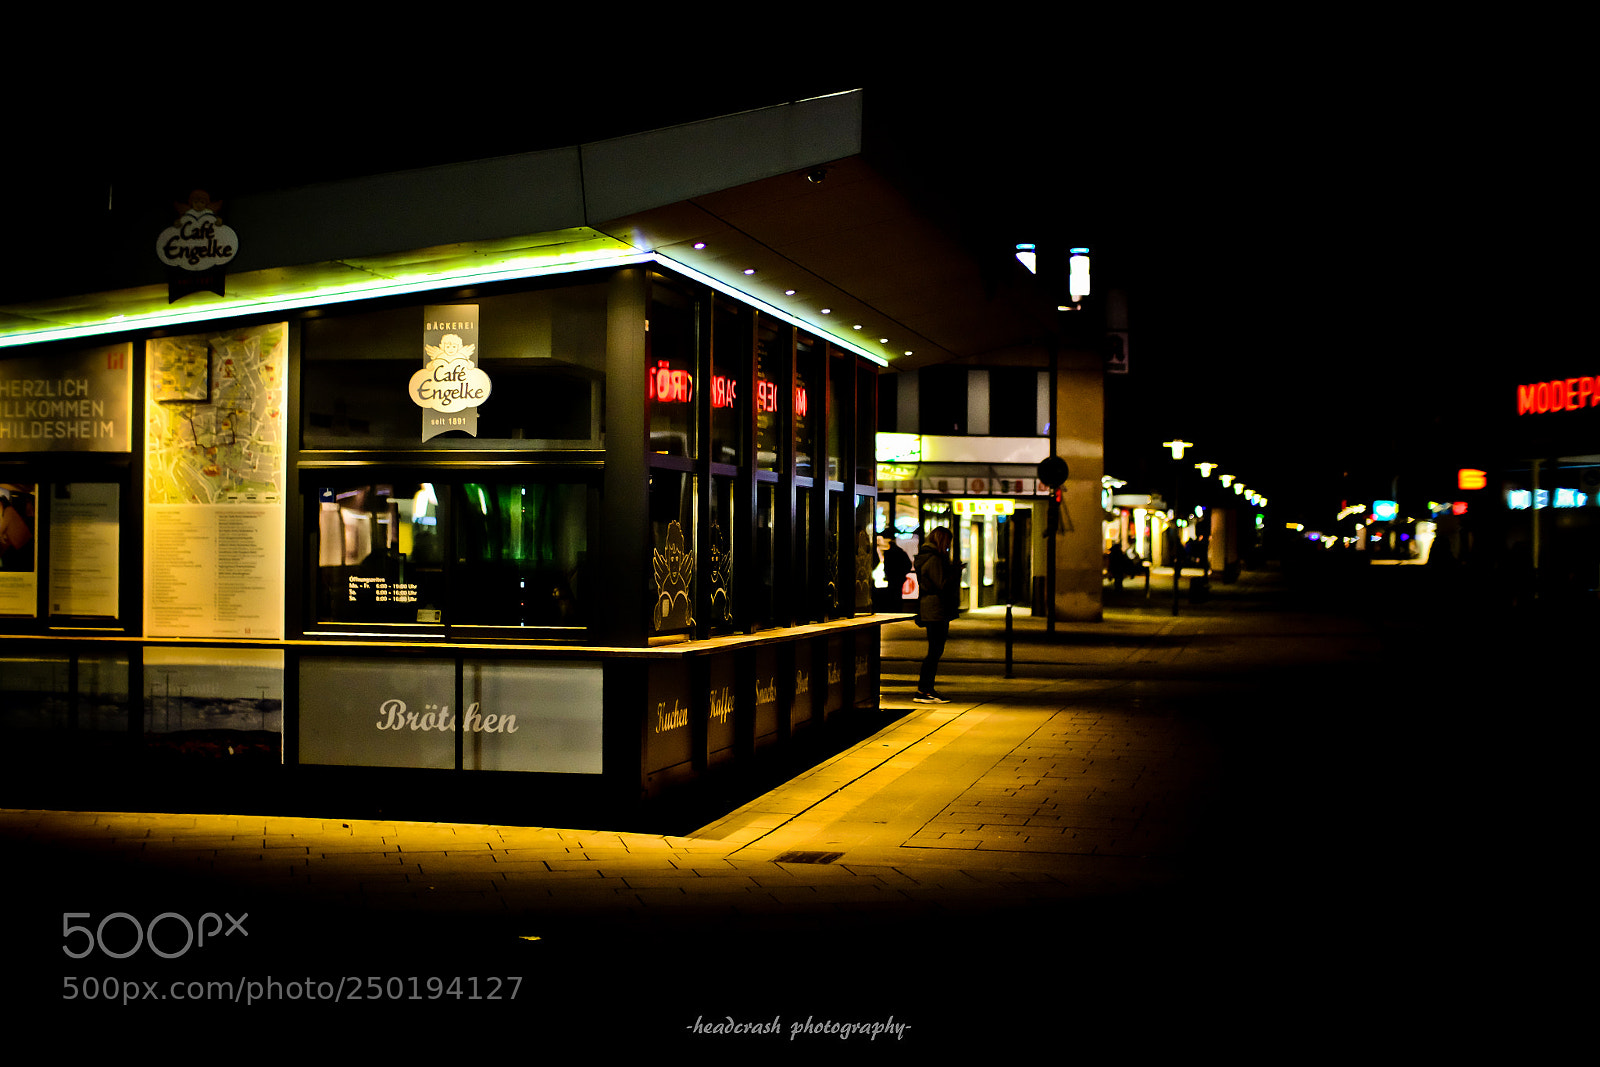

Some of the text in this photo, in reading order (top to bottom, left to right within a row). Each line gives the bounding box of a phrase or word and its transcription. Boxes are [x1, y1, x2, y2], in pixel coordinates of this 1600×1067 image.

[180, 221, 215, 240] Café
[163, 236, 233, 265] Engelke
[426, 321, 474, 331] BÄCKEREI
[433, 365, 466, 382] Café
[0, 379, 89, 398] HERZLICH
[417, 379, 484, 406] Engelke
[0, 421, 114, 439] HILDESHEIM
[655, 698, 688, 733] Kuchen
